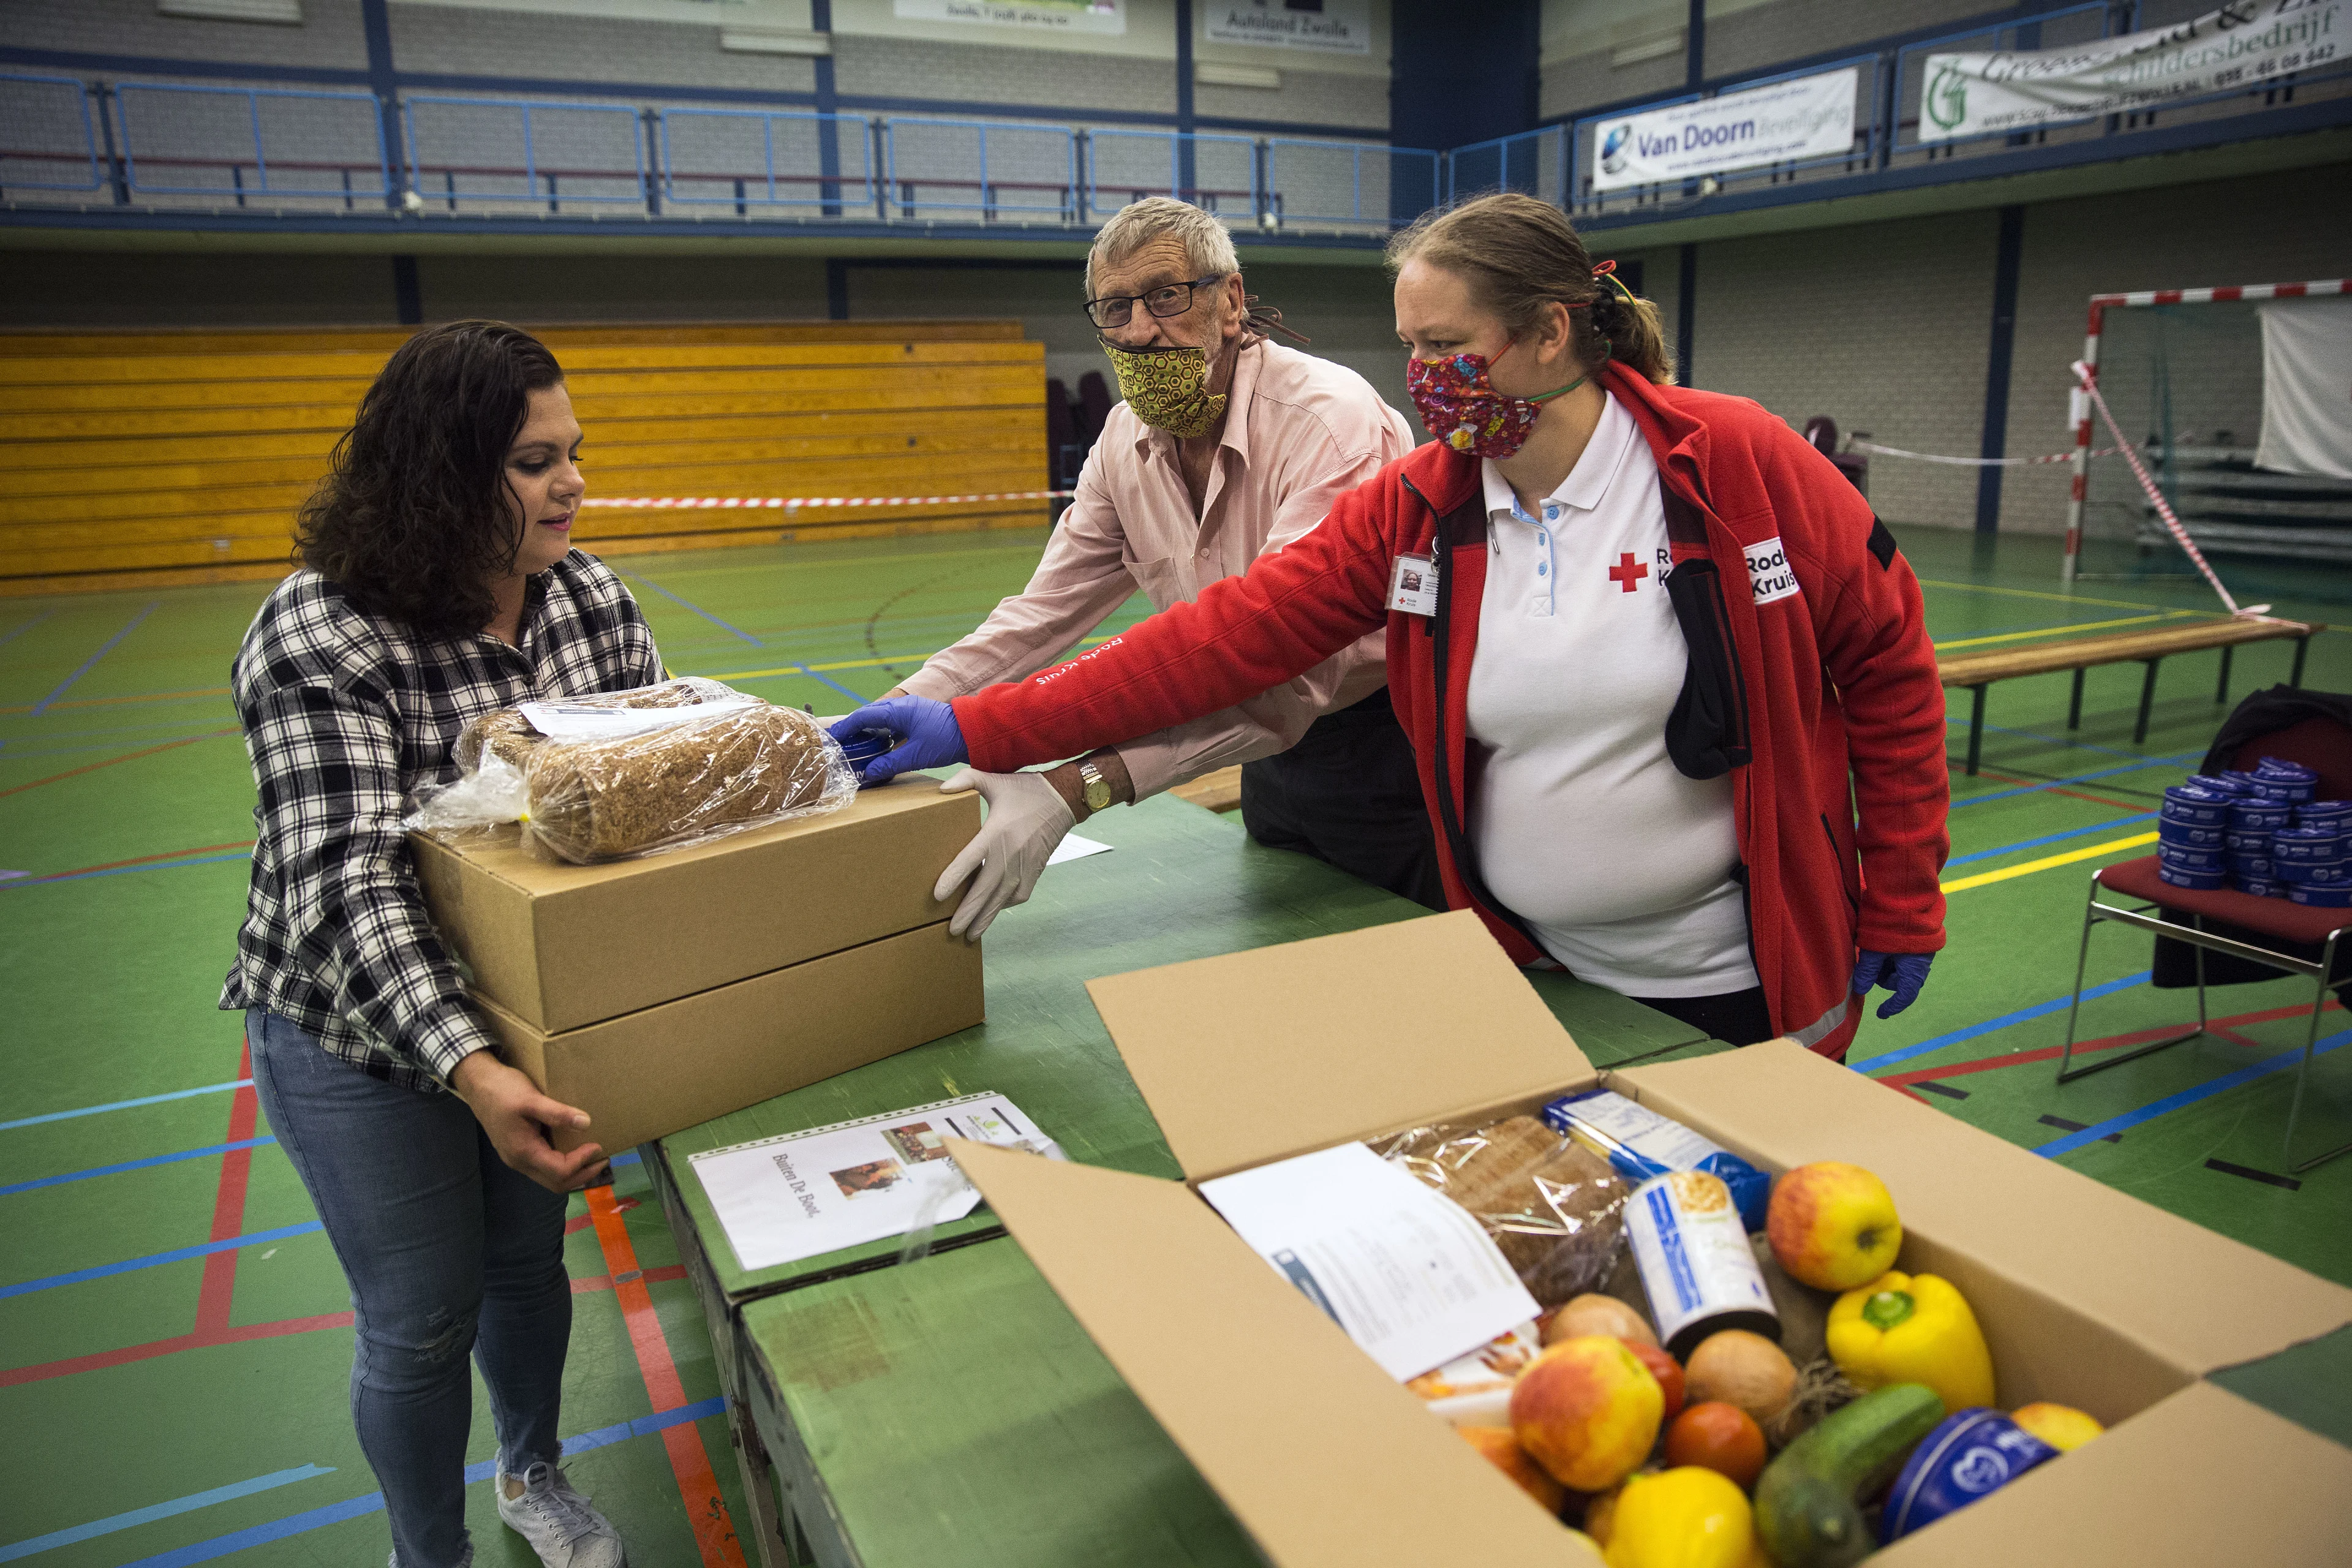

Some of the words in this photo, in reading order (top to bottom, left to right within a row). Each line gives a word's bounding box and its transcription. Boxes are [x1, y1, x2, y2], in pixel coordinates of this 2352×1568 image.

[1638, 131, 1677, 158] Van
[1684, 119, 1755, 151] Doorn
[1746, 549, 1789, 573] Rod
[1080, 637, 1123, 661] Rode
[1036, 662, 1079, 685] Kruis
[773, 1153, 796, 1181] Buiten
[790, 1180, 805, 1194] De
